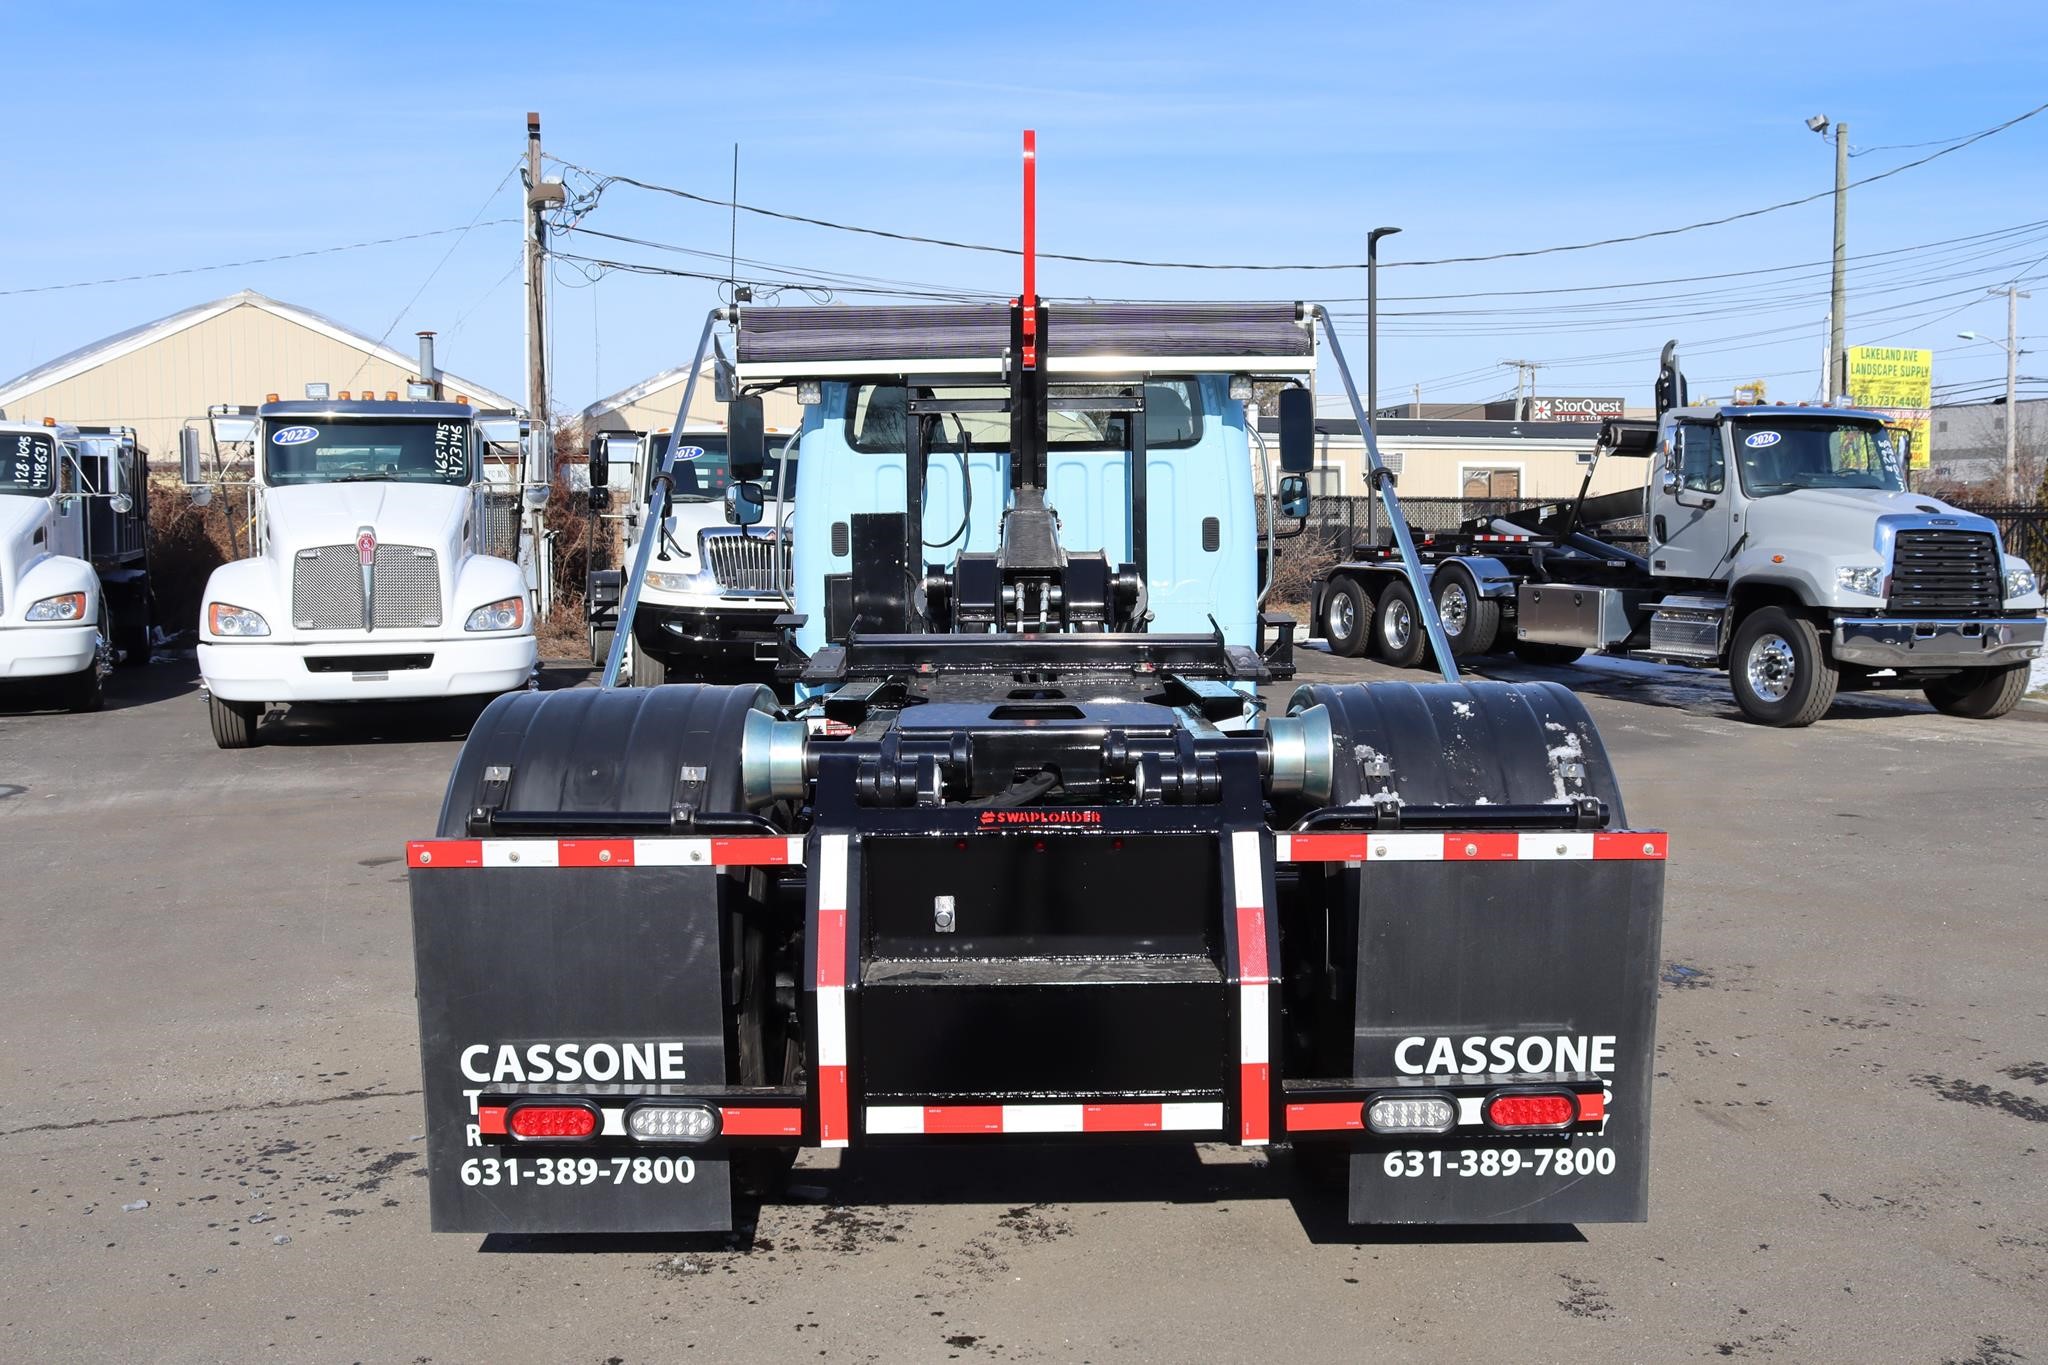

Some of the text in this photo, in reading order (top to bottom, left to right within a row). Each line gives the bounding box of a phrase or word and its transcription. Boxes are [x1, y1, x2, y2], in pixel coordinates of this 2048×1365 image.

[1860, 347, 1918, 362] LAKELAND AVE
[1851, 363, 1929, 377] LANDSCAPE SUPPLY
[1554, 399, 1621, 415] StorQuest
[279, 429, 312, 443] 2022
[1752, 434, 1775, 445] 2026
[33, 441, 48, 487] 448631
[997, 811, 1101, 823] SWAPLOADER
[460, 1043, 686, 1083] CASSONE
[1394, 1035, 1617, 1075] CASSONE
[1383, 1147, 1616, 1177] 631-389-7800
[460, 1157, 696, 1186] 631-389-7800
